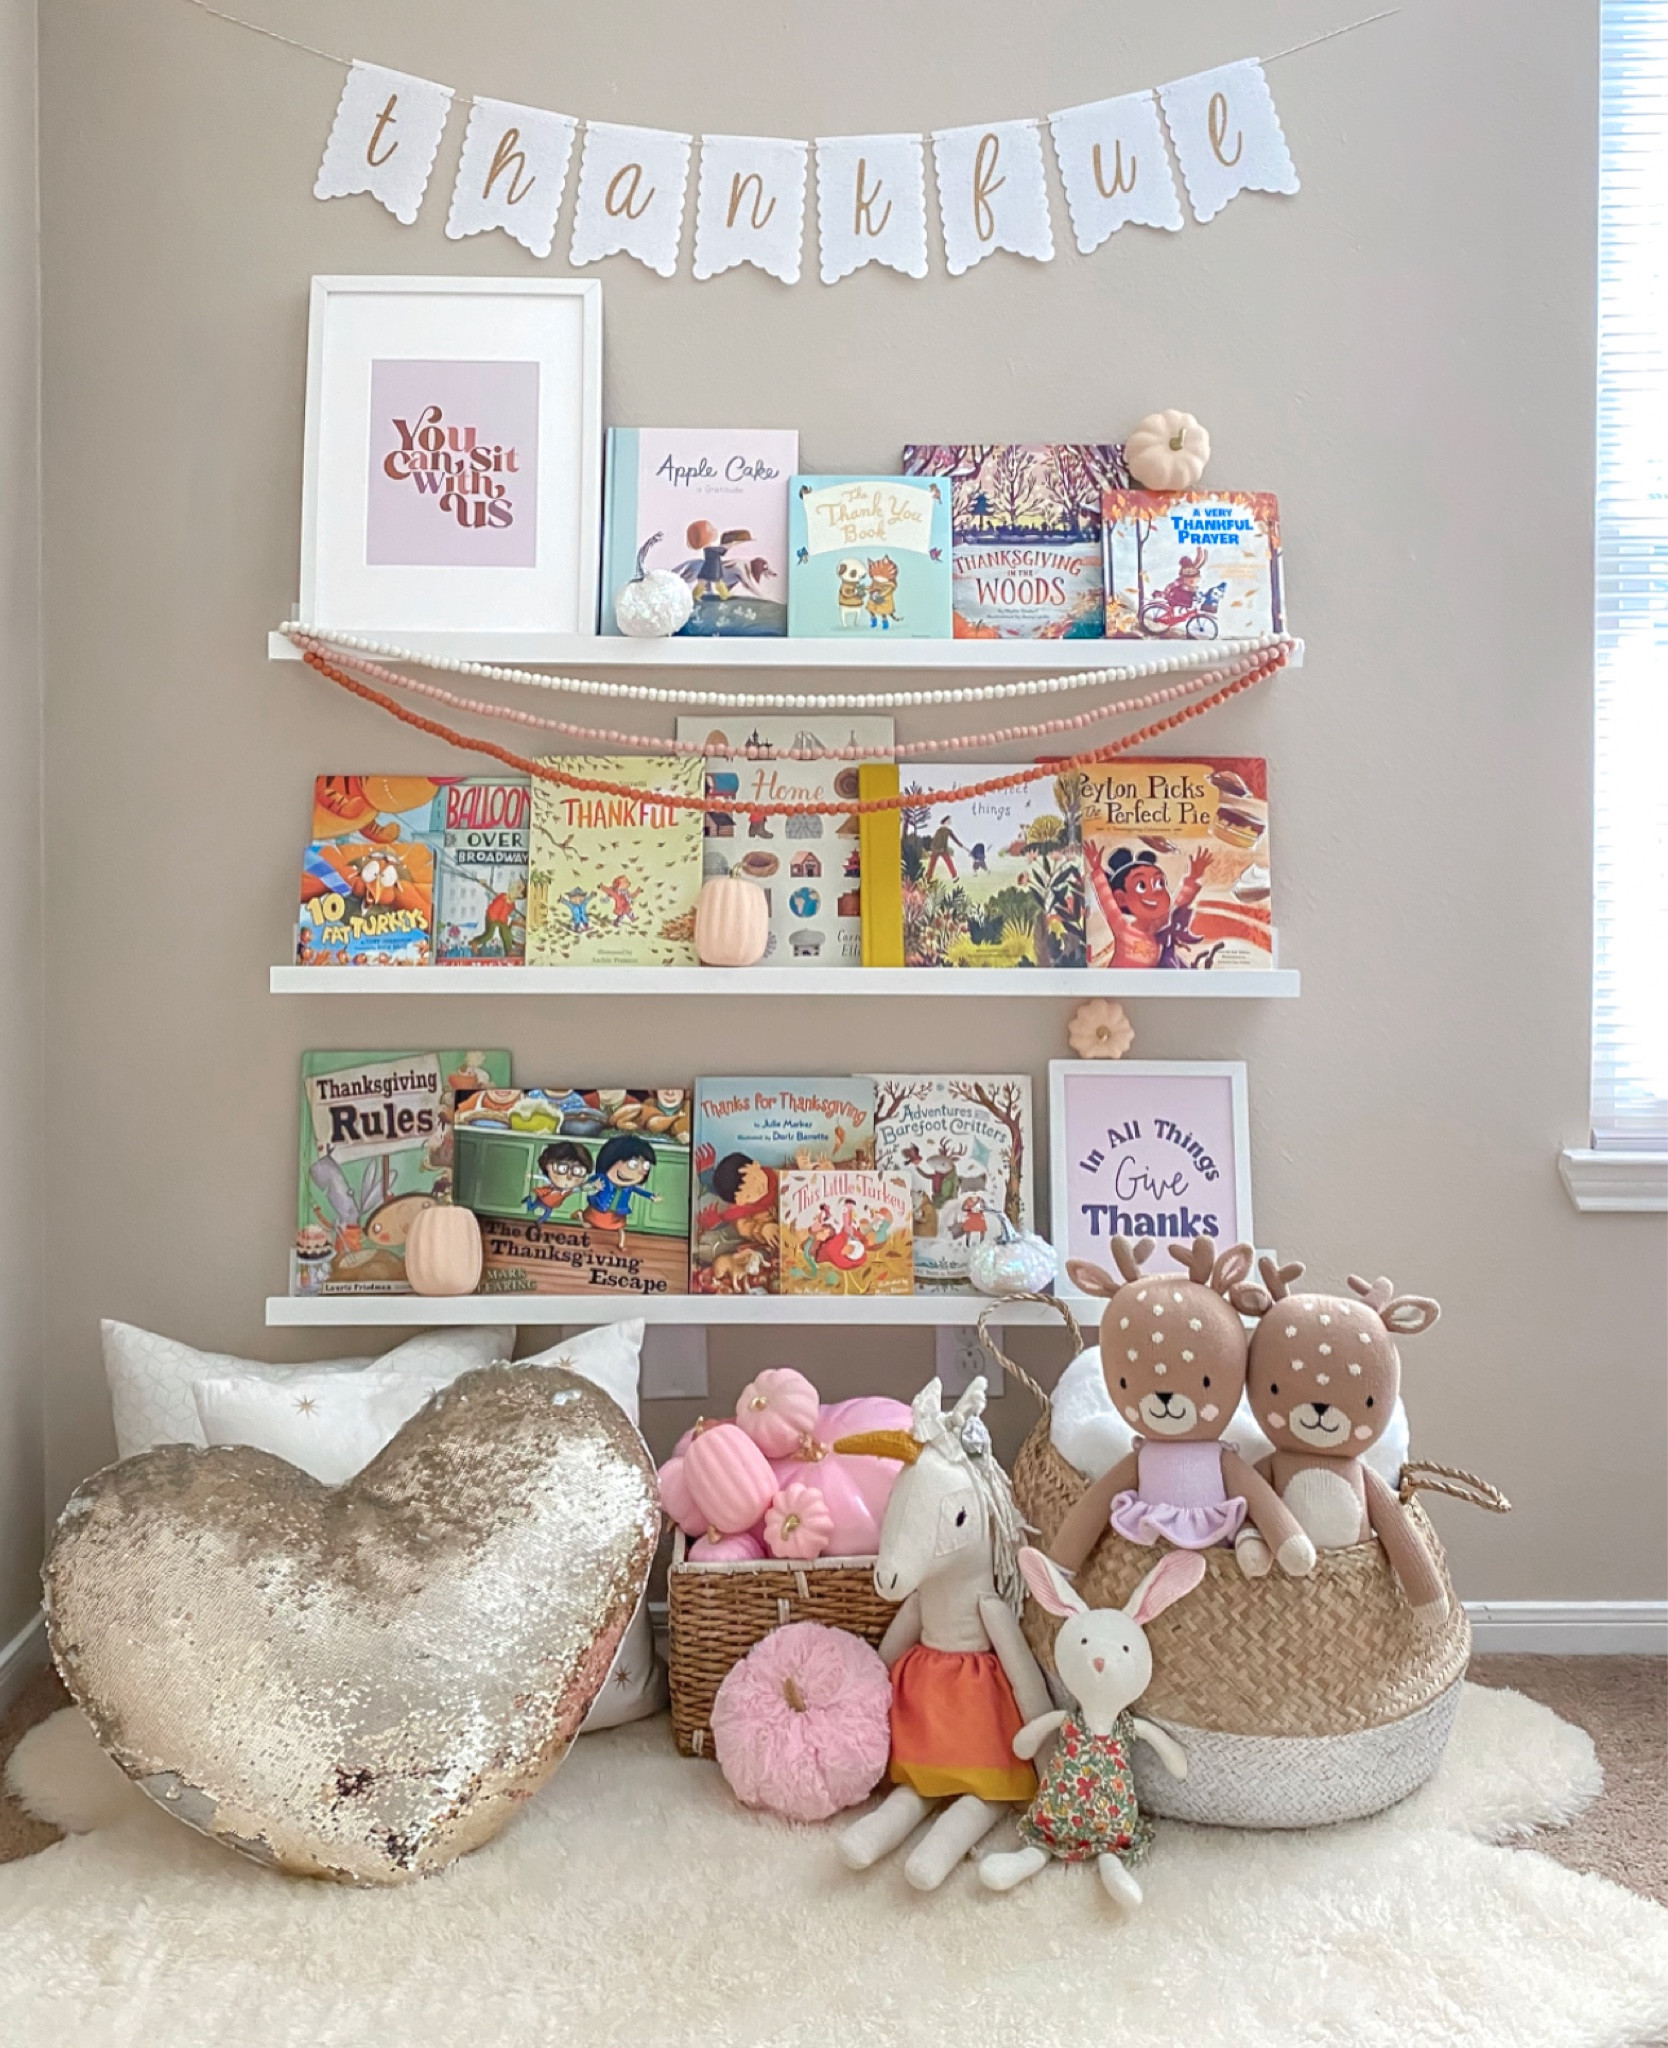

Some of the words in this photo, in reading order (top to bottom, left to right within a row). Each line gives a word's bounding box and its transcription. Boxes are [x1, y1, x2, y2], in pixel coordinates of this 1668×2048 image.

[366, 92, 1242, 241] thankful
[391, 405, 476, 452] You
[656, 454, 717, 486] Apple
[724, 456, 780, 481] Cake
[816, 491, 883, 526] Thank
[887, 496, 923, 525] You
[841, 486, 867, 502] The
[1170, 516, 1254, 531] THANKFUL
[1193, 508, 1200, 517] A
[1204, 508, 1233, 517] VERY
[841, 521, 887, 543] Book
[1177, 530, 1240, 545] PRAYER
[954, 548, 1084, 577] THANKSGIVING
[975, 576, 1066, 606] WOODS
[751, 768, 824, 801] Home
[1147, 775, 1205, 799] Picks
[560, 798, 680, 829] THANKFUL
[972, 802, 1011, 820] things
[1104, 798, 1171, 824] Perfect
[1177, 801, 1211, 825] Pie
[467, 832, 523, 848] OVER
[458, 850, 529, 865] BROADWAY
[308, 893, 346, 926] 10
[322, 925, 350, 945] FAT
[350, 909, 429, 939] TURKEYS
[317, 1070, 438, 1100] Thanksgiving
[329, 1103, 434, 1143] Rules
[701, 1095, 750, 1118] Thanks
[754, 1092, 777, 1110] for
[779, 1092, 867, 1128] Thanksgiving
[900, 1103, 972, 1122] Adventures
[880, 1119, 948, 1145] Barefoot
[950, 1119, 1007, 1144] Critters
[1080, 1149, 1105, 1173] In
[1107, 1120, 1141, 1148] All
[1154, 1118, 1220, 1182] Things
[1115, 1155, 1189, 1201] Give
[792, 1183, 820, 1213] This
[822, 1173, 855, 1197] Little
[856, 1174, 905, 1216] Turkey
[485, 1221, 521, 1237] The
[525, 1225, 591, 1248] Great
[1081, 1204, 1219, 1237] Thanks
[490, 1239, 641, 1274] Thanksgiving
[588, 1268, 668, 1295] Escape
